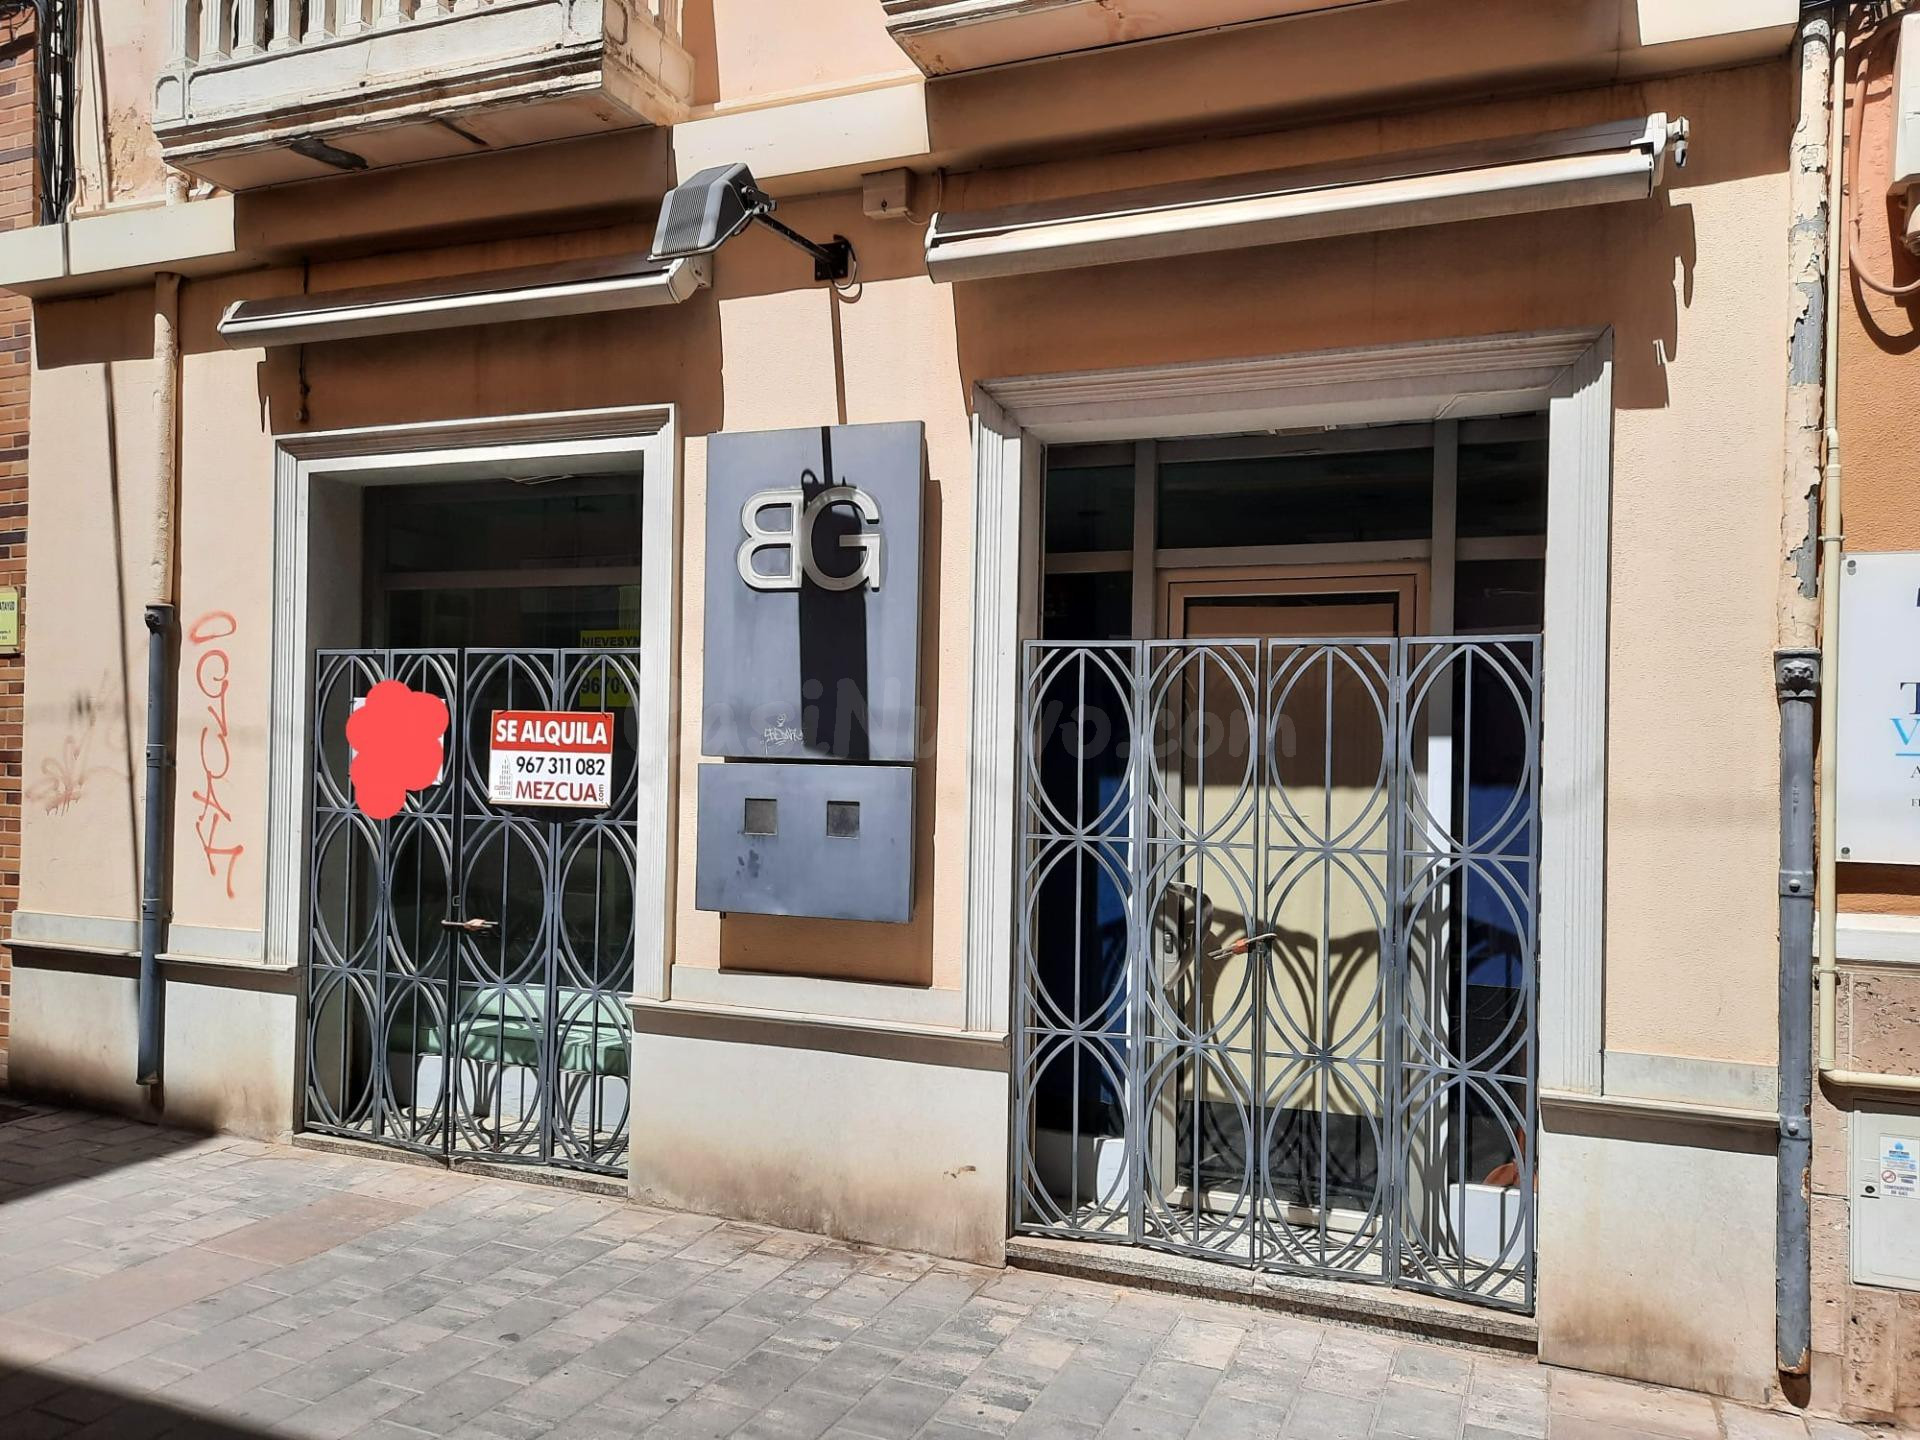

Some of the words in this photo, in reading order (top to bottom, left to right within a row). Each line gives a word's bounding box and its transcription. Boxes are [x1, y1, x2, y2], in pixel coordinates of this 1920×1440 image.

[495, 719, 518, 742] SE
[520, 720, 608, 746] ALQUILA
[516, 756, 545, 773] 967
[548, 757, 572, 775] 311
[575, 758, 605, 776] 082
[515, 780, 598, 802] MEZCUA
